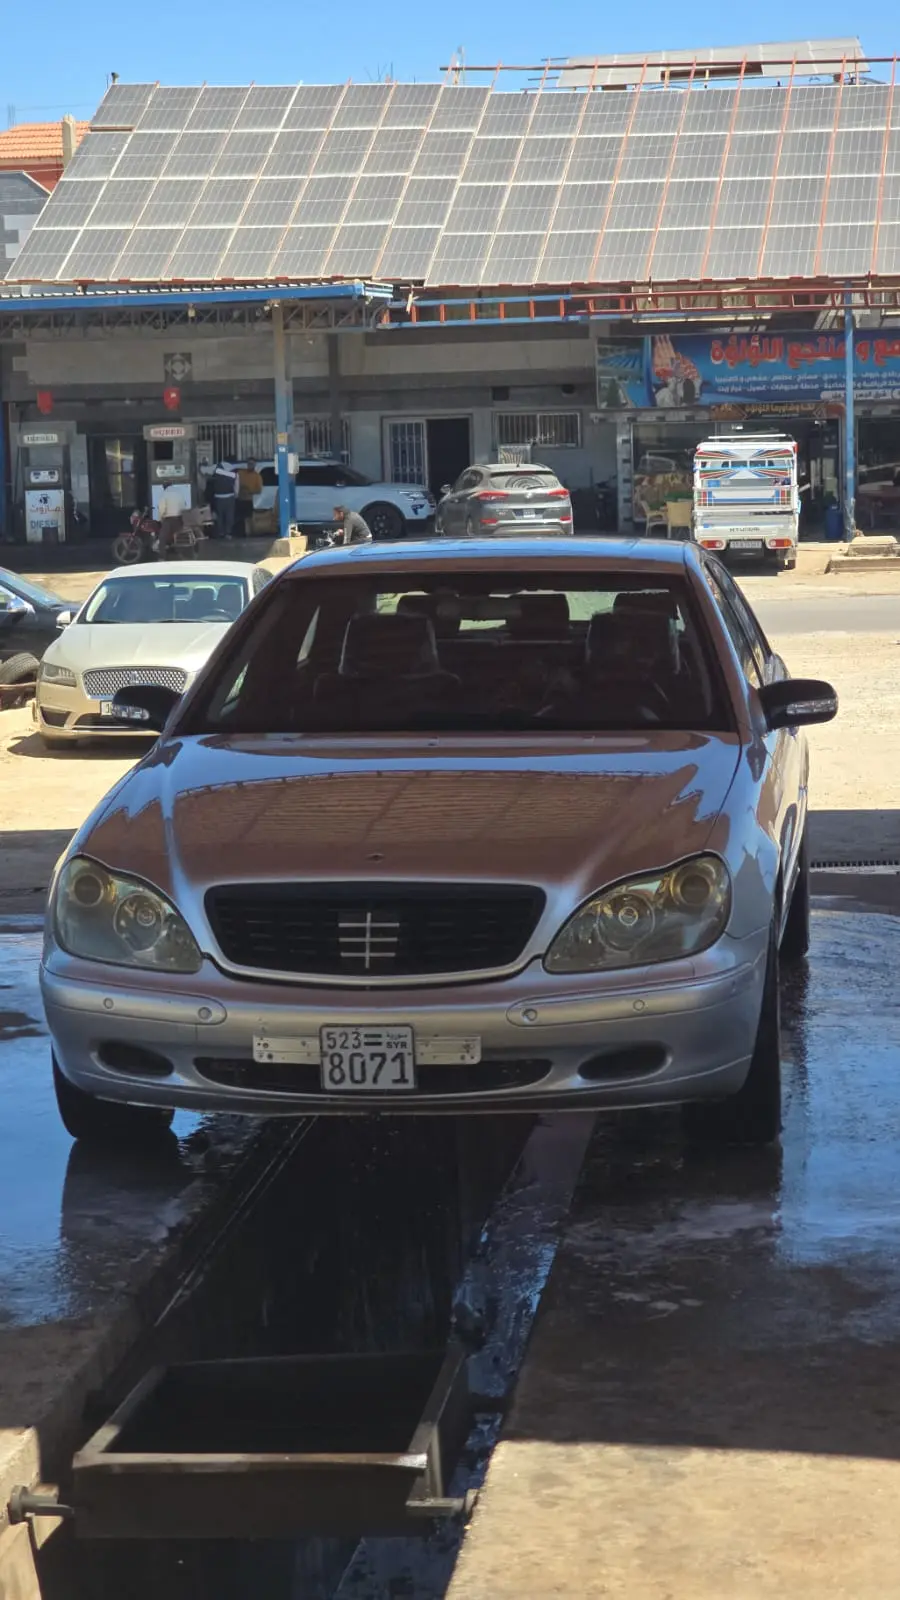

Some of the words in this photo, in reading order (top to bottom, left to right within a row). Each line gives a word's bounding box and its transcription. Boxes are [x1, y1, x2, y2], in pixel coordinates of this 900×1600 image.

[326, 1030, 361, 1050] 523
[386, 1041, 407, 1049] SYR
[329, 1052, 409, 1085] 8071
